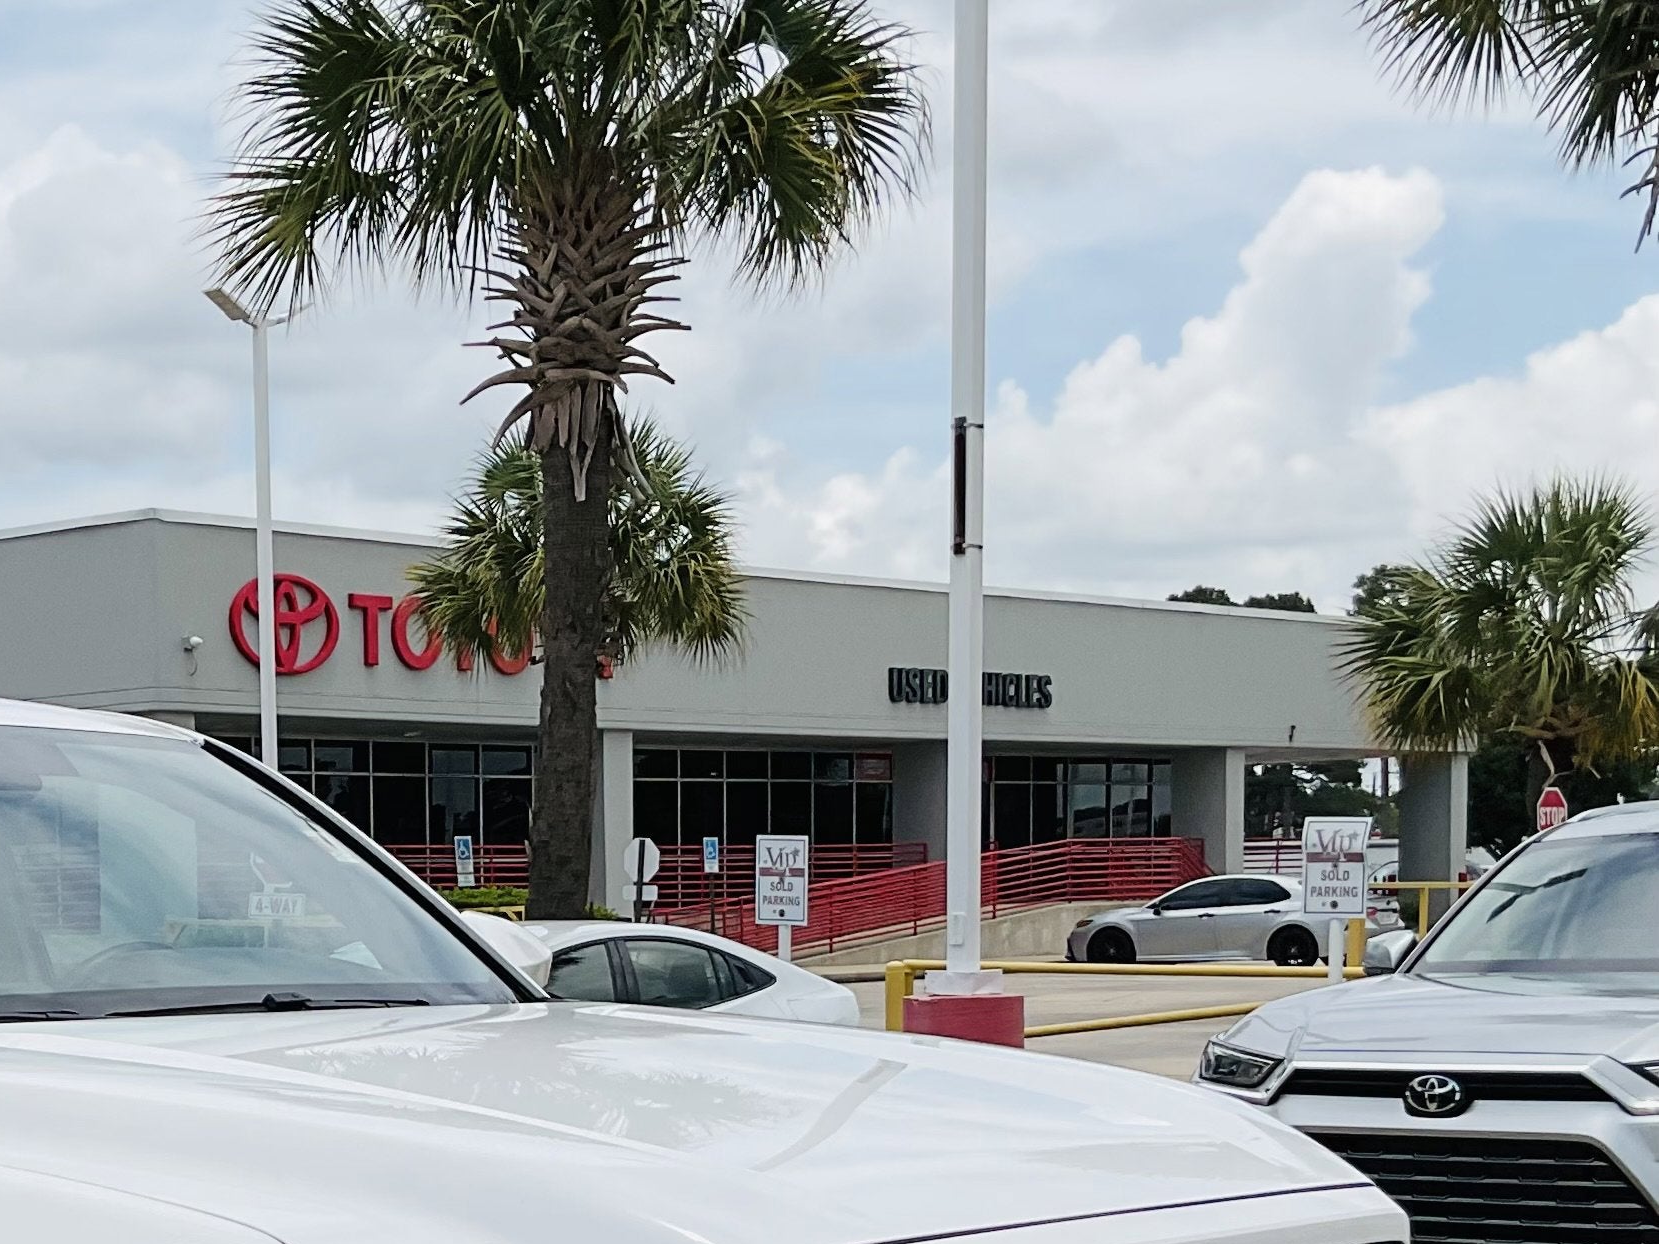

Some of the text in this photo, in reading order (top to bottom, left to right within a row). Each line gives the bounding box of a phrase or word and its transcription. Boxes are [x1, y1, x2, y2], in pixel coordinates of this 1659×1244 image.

[888, 667, 1053, 709] USED HICLES
[1539, 806, 1565, 826] STOP
[1321, 869, 1350, 881] SOLD
[769, 881, 794, 892] SOLD
[1310, 886, 1359, 898] PARKING
[255, 897, 298, 914] 4-WAY
[762, 895, 801, 906] PARKING
